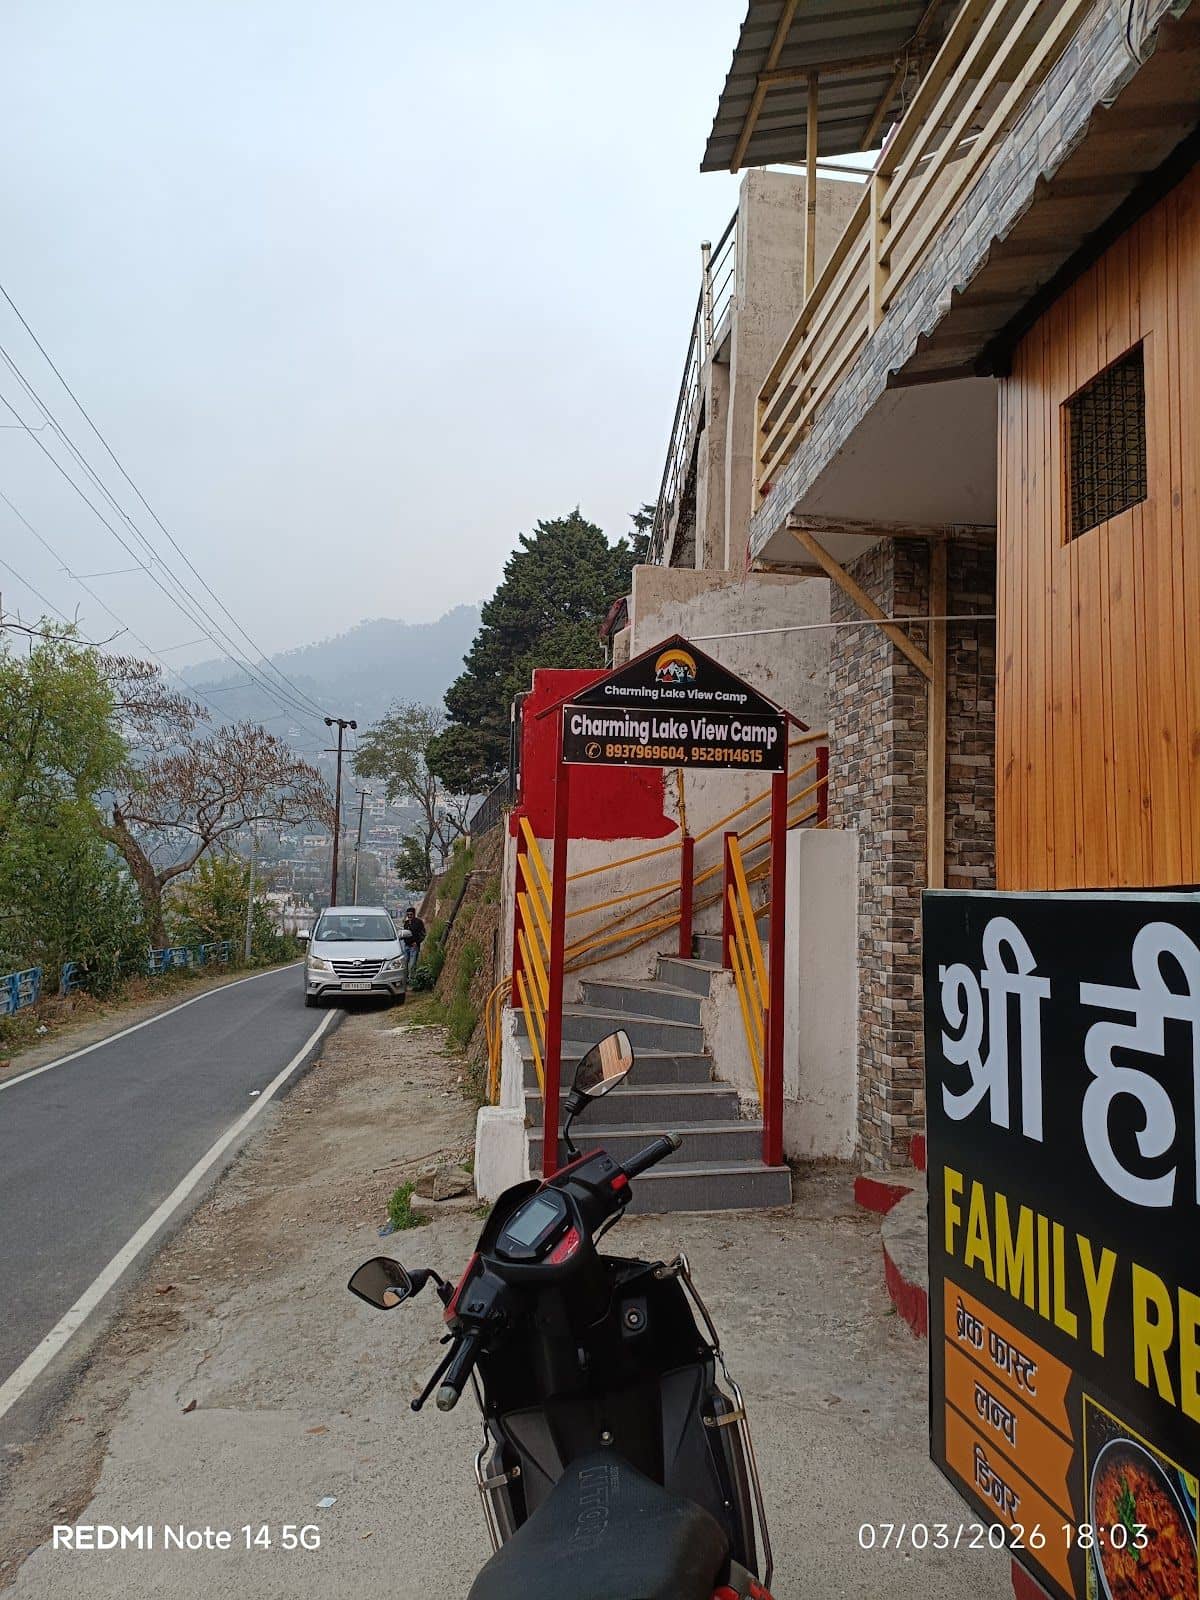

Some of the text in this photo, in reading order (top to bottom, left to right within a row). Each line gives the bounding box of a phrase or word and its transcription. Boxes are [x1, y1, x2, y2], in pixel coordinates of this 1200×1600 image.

[604, 685, 748, 704] Charming Lake View Camp
[571, 713, 778, 749] Charming Lake View Camp
[606, 743, 763, 763] 8937969604, 9528114615
[938, 916, 1051, 1143] श्री
[943, 1165, 1117, 1358] FAMILY
[956, 1296, 985, 1350] ब्रेक
[973, 1441, 1022, 1524] डिनर
